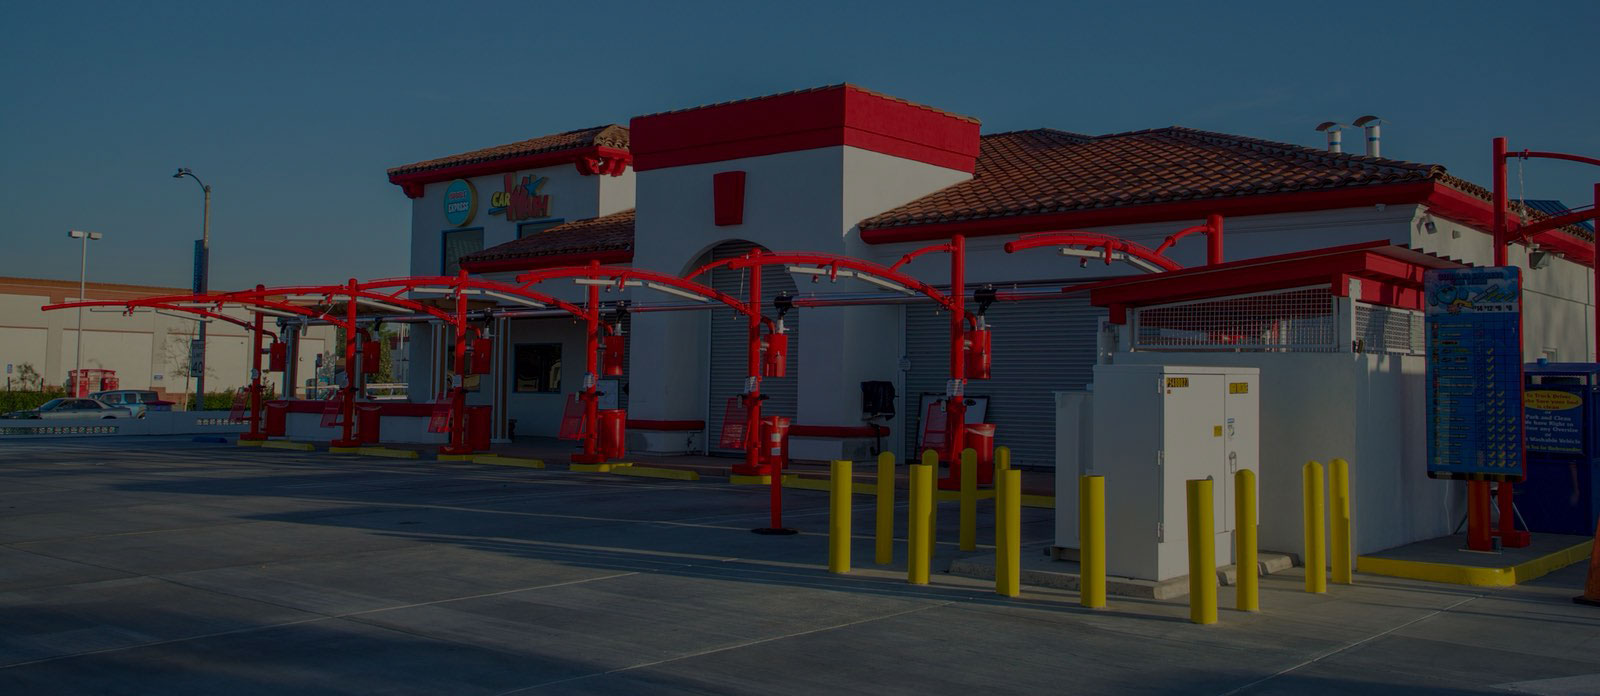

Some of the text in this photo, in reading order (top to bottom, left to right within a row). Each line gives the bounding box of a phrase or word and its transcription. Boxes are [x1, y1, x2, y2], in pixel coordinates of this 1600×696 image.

[491, 192, 511, 207] CAR
[448, 202, 469, 213] EXPRESS
[192, 362, 203, 374] 40
